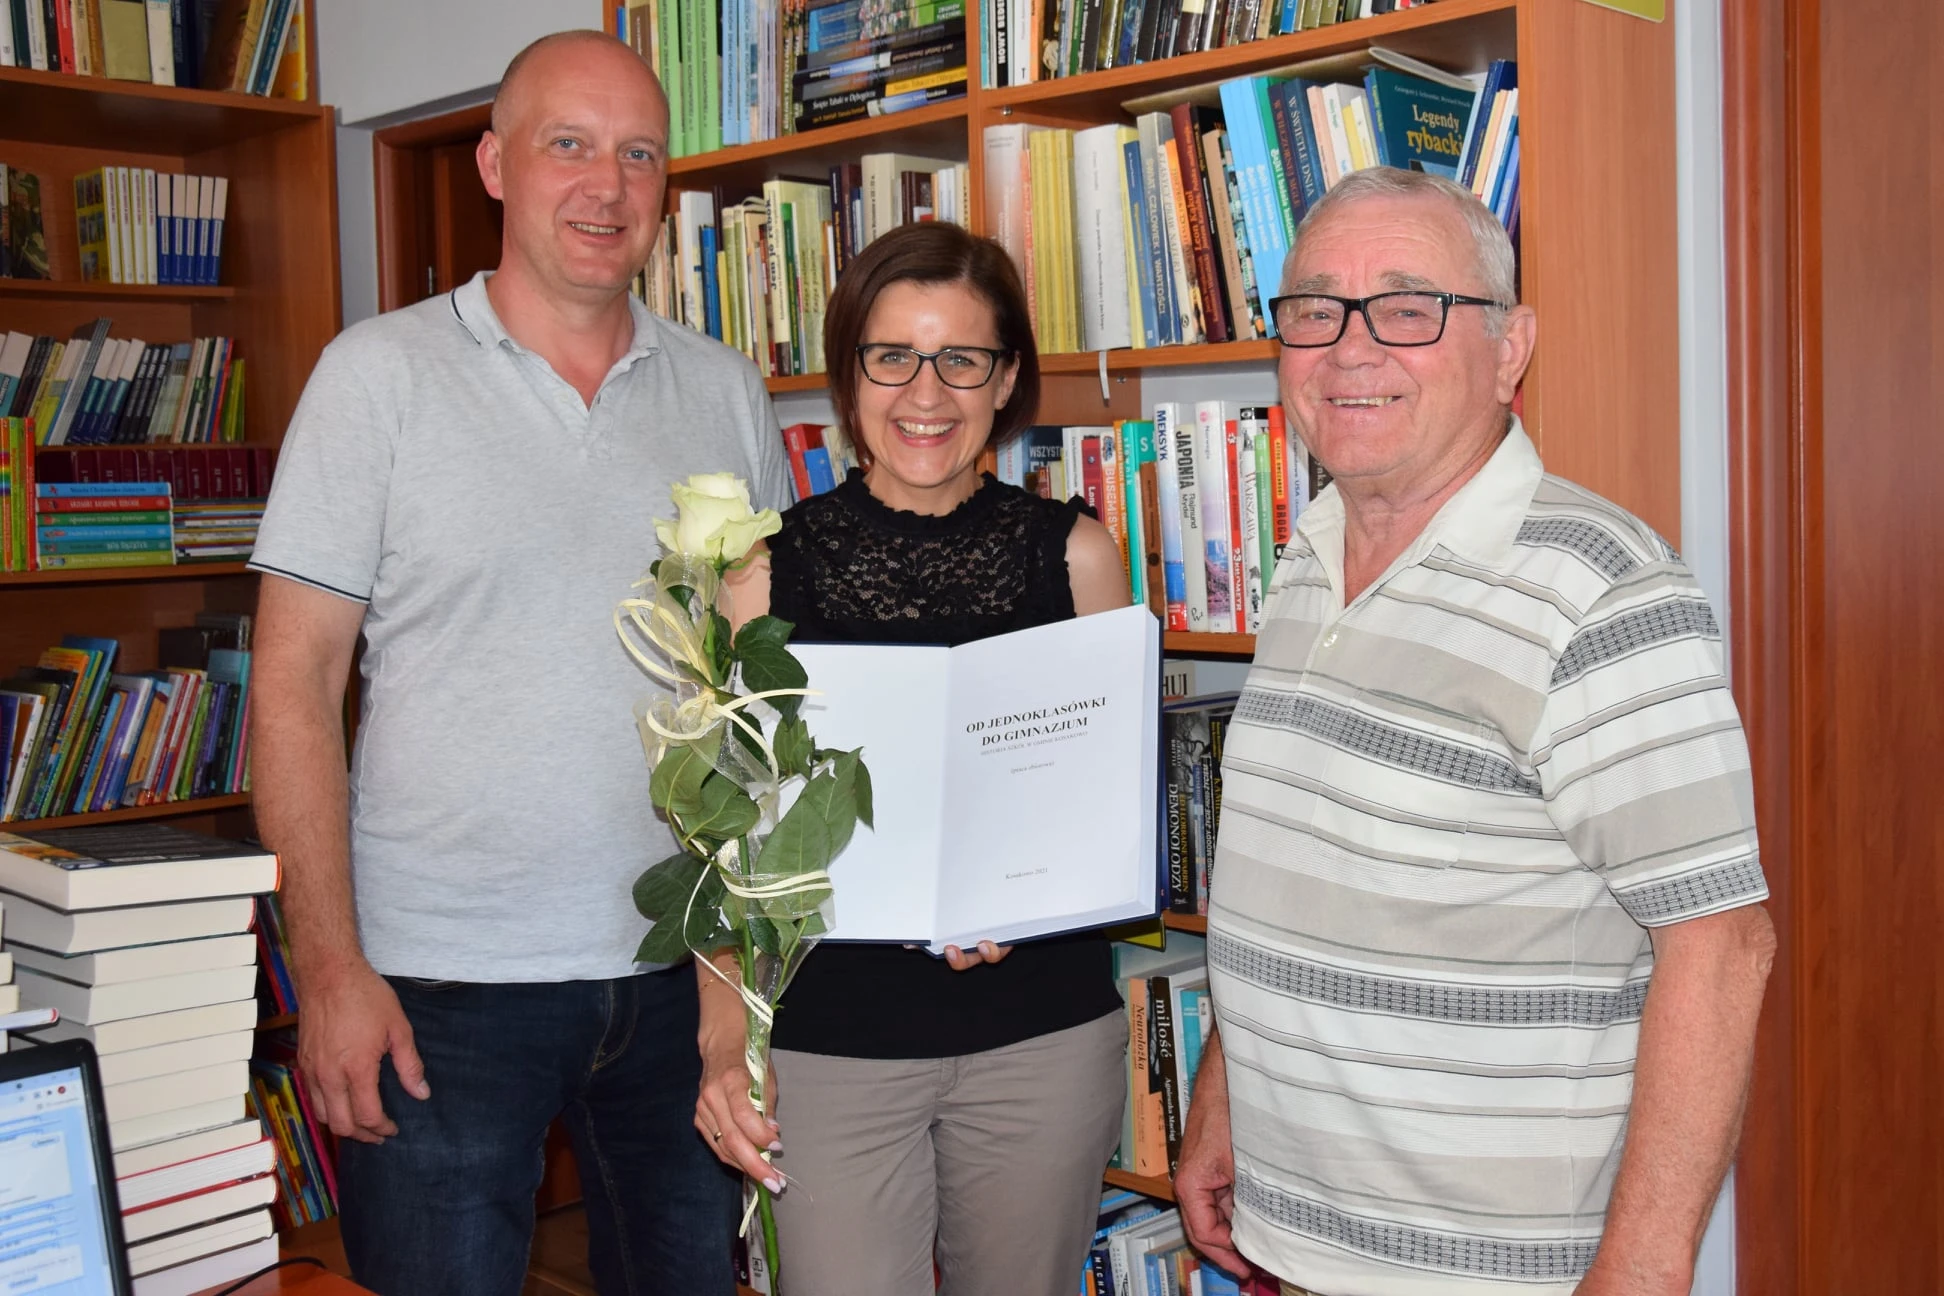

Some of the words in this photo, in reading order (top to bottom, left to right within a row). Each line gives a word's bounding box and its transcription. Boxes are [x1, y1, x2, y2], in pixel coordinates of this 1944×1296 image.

[997, 31, 1006, 64] NOWY
[1273, 99, 1282, 109] W
[1286, 95, 1299, 109] W
[1412, 103, 1460, 134] Legendy
[1287, 109, 1313, 163] ŚWIETLE
[1158, 152, 1171, 199] KLASYCY
[1299, 163, 1318, 198] DNIA
[1146, 194, 1162, 248] CZŁOWIEK
[1164, 201, 1175, 231] PRAW
[1184, 190, 1198, 222] Kąkol
[1168, 233, 1181, 274] NATURY
[1190, 224, 1202, 251] Leon
[1152, 259, 1167, 315] WARTOŚCI
[1029, 445, 1064, 459] WSZYST
[1156, 409, 1168, 461] MEKSYK
[1175, 430, 1195, 490] JAPONIA
[1103, 467, 1118, 512] BUSEM
[1243, 471, 1261, 542] WARSZAWA
[1188, 493, 1198, 529] Rajmund
[1275, 503, 1289, 541] DROGA
[966, 721, 985, 734] OD
[988, 696, 1106, 729] JEDNOKLASÓWKI
[982, 733, 1001, 746] DO
[1004, 717, 1088, 741] GIMNAZJUM
[1179, 812, 1188, 854] LORRAINE
[1181, 856, 1190, 892] WARREN
[1132, 1004, 1151, 1071] Neurolożka
[1154, 998, 1174, 1059] miłość
[1163, 1077, 1175, 1114] Agnieszka
[1167, 1115, 1177, 1142] Maciąg
[1094, 1256, 1105, 1295] MICHA
